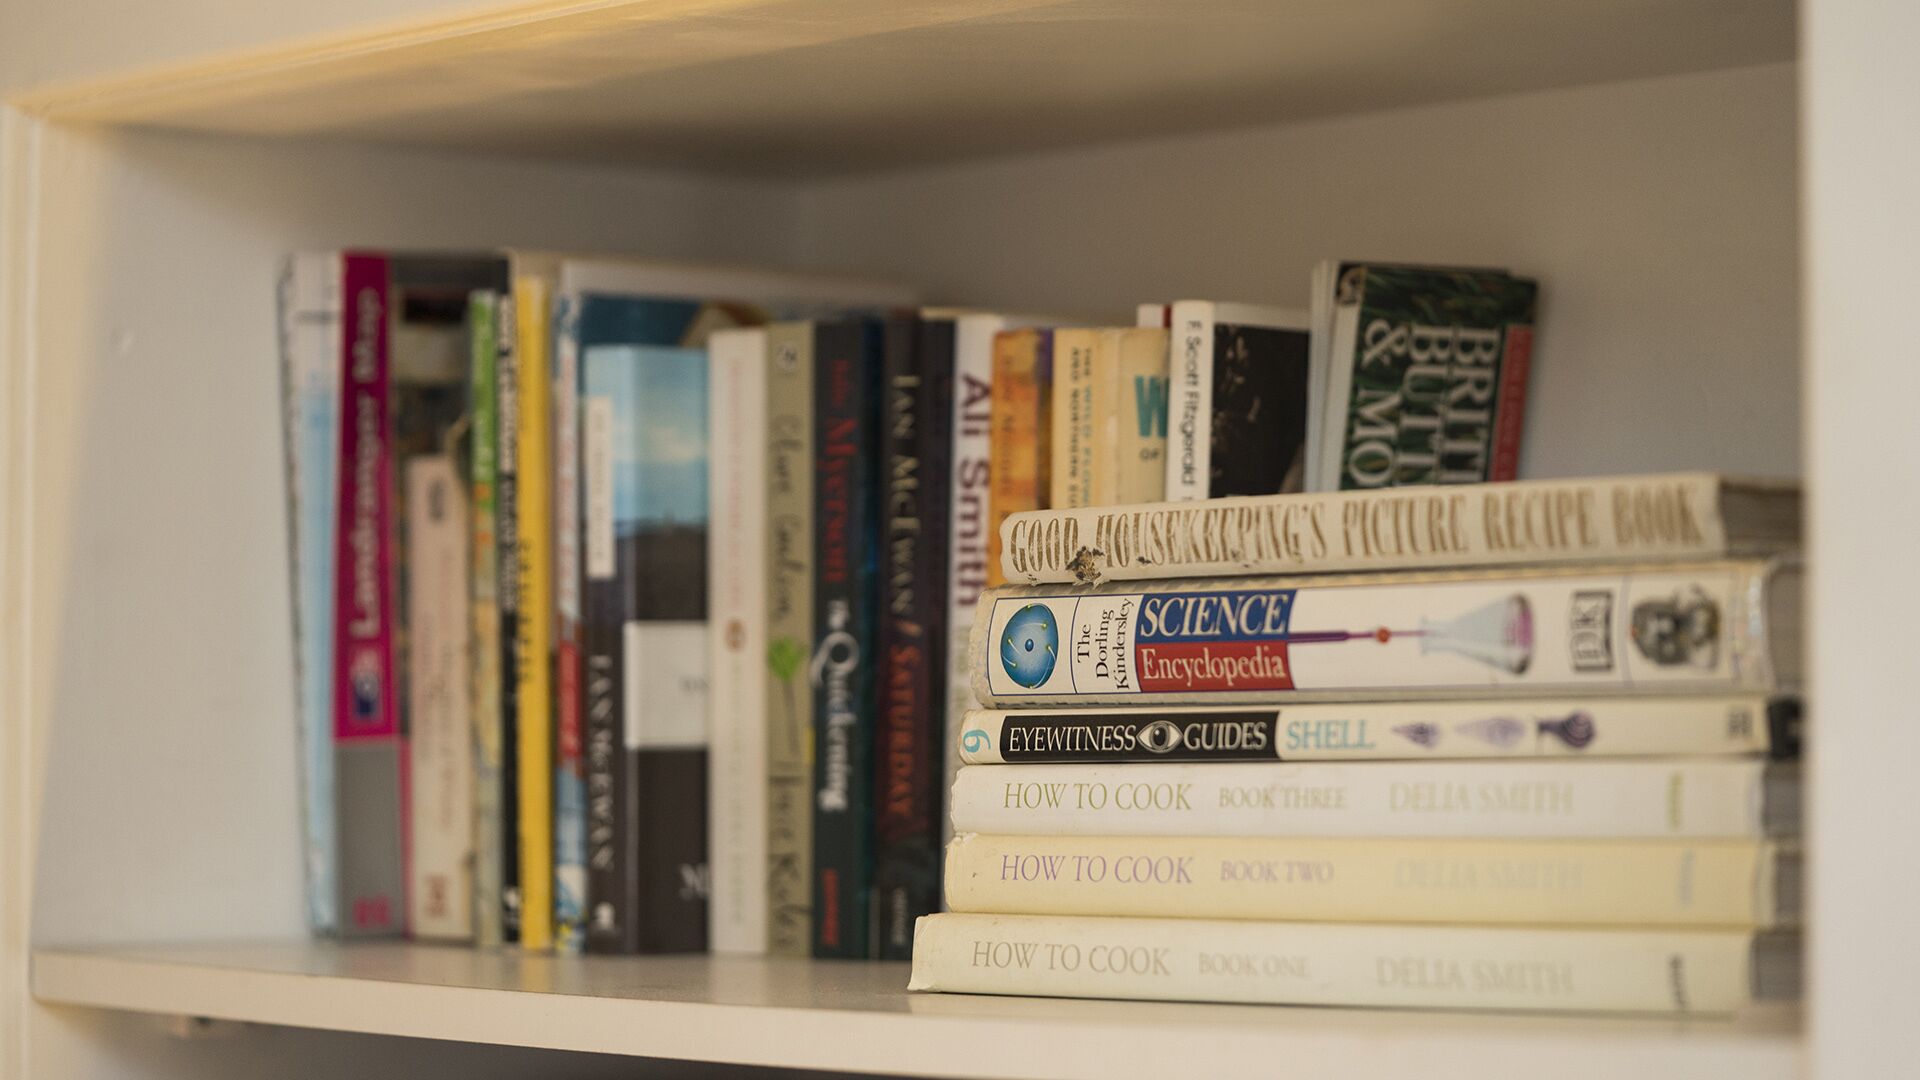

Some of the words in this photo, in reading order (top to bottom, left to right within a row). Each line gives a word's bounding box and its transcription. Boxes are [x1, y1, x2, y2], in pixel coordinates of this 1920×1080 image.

[1185, 336, 1202, 387] Scott
[1361, 318, 1408, 368] &
[961, 374, 990, 436] Ali
[1180, 390, 1201, 487] Fitzgerald
[958, 458, 990, 608] Smith
[1010, 517, 1080, 573] GOOD
[1095, 502, 1327, 568] HOUSEKEEPING'S
[1343, 493, 1468, 557] PICTURE
[1482, 487, 1596, 550] RECIPE
[1611, 482, 1704, 547] BOOK
[1139, 593, 1289, 637] SCIENCE
[1077, 624, 1092, 664] The
[1095, 609, 1115, 679] Dorling
[1112, 598, 1134, 690] Kindersley
[1142, 647, 1287, 687] Encyclopedia
[809, 631, 860, 813] Quickening
[962, 729, 992, 754] 6
[1008, 725, 1137, 753] EYEWITNESS
[1183, 721, 1268, 751] GUIDES
[1285, 719, 1377, 751] SHELL
[1003, 782, 1068, 810] HOW
[1073, 783, 1108, 810] TO
[1115, 783, 1193, 811] COOK
[1218, 787, 1278, 810] BOOK
[1281, 787, 1348, 810] THREE
[1389, 782, 1471, 813] DELIA
[1477, 783, 1575, 816] SMITH
[1001, 854, 1066, 882] HOW
[1072, 855, 1108, 882] TO
[1114, 855, 1195, 884] COOK
[1219, 860, 1278, 882] BOOK
[1283, 861, 1335, 883] TWO
[972, 941, 1038, 969] HOW
[1044, 943, 1081, 971] TO
[1088, 945, 1171, 976] COOK
[1198, 951, 1258, 975] BOOK
[1262, 952, 1311, 978] ONE
[1375, 956, 1466, 990] DELIA
[1470, 958, 1576, 995] SMITH
